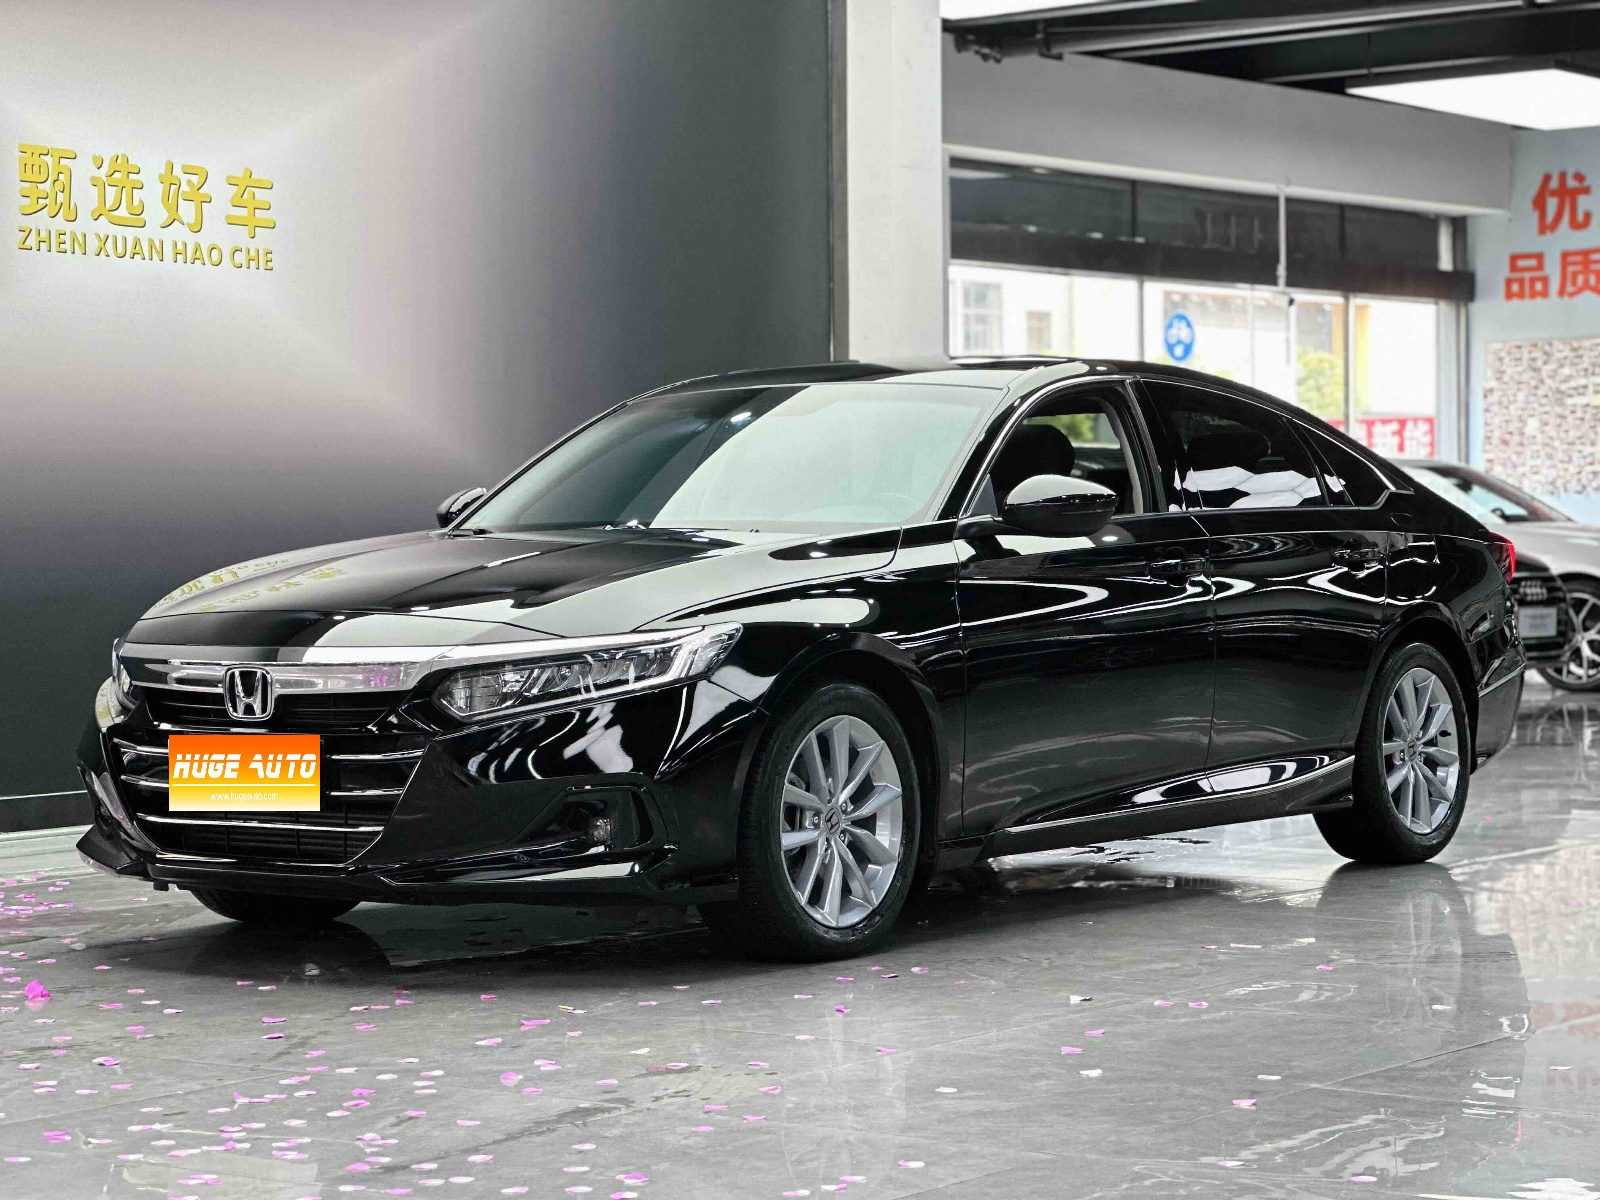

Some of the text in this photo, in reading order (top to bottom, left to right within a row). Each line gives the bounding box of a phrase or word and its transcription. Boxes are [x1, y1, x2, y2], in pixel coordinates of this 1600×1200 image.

[18, 143, 276, 238] 甄选好车
[1531, 170, 1592, 236] 优
[17, 225, 274, 271] ZHEN XUAN HAO CHE
[1505, 248, 1600, 301] 品质
